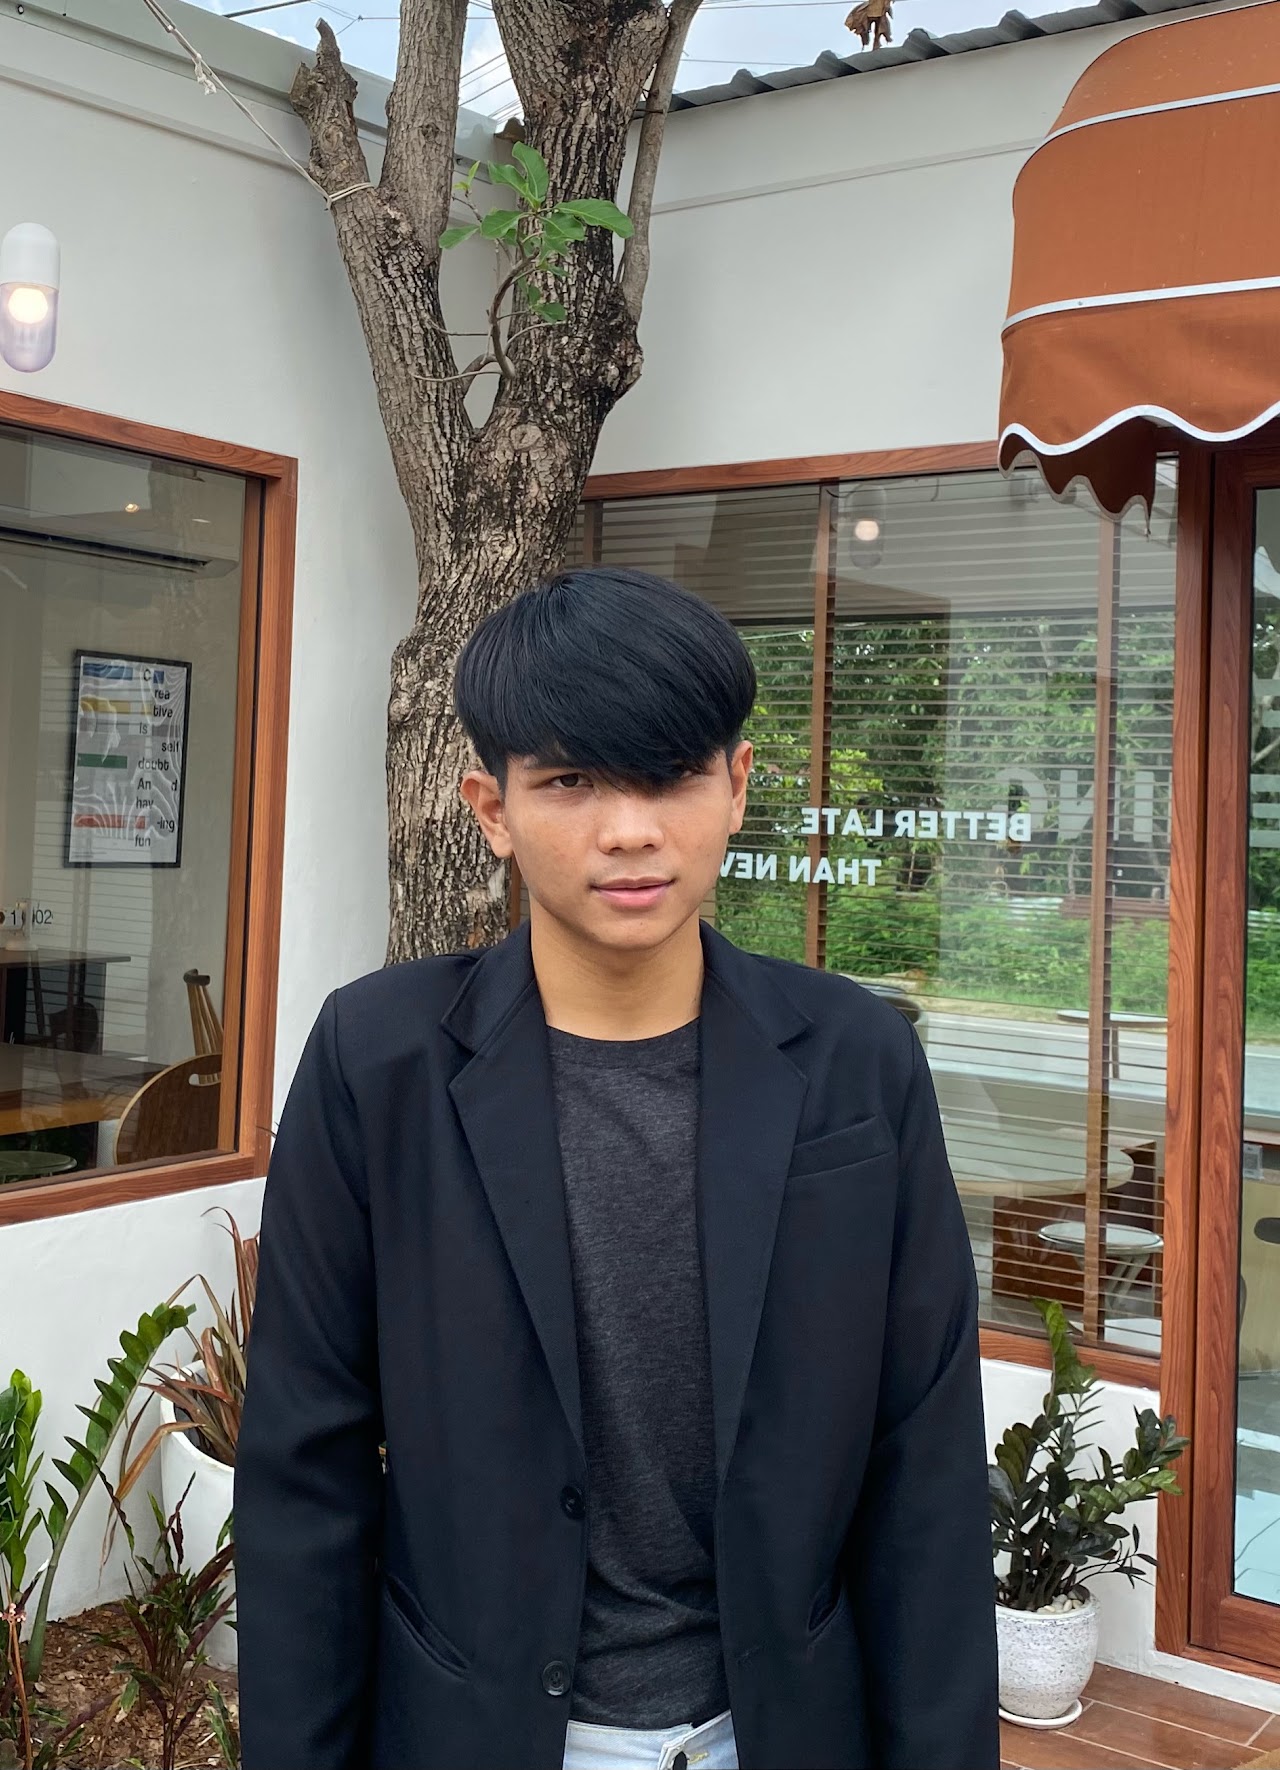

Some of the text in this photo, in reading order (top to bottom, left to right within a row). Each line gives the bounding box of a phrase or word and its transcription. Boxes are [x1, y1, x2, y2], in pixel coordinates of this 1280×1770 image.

[154, 689, 170, 700] rea
[153, 704, 173, 718] tive
[138, 757, 169, 771] doubt
[136, 797, 154, 809] hav
[135, 835, 151, 847] fun
